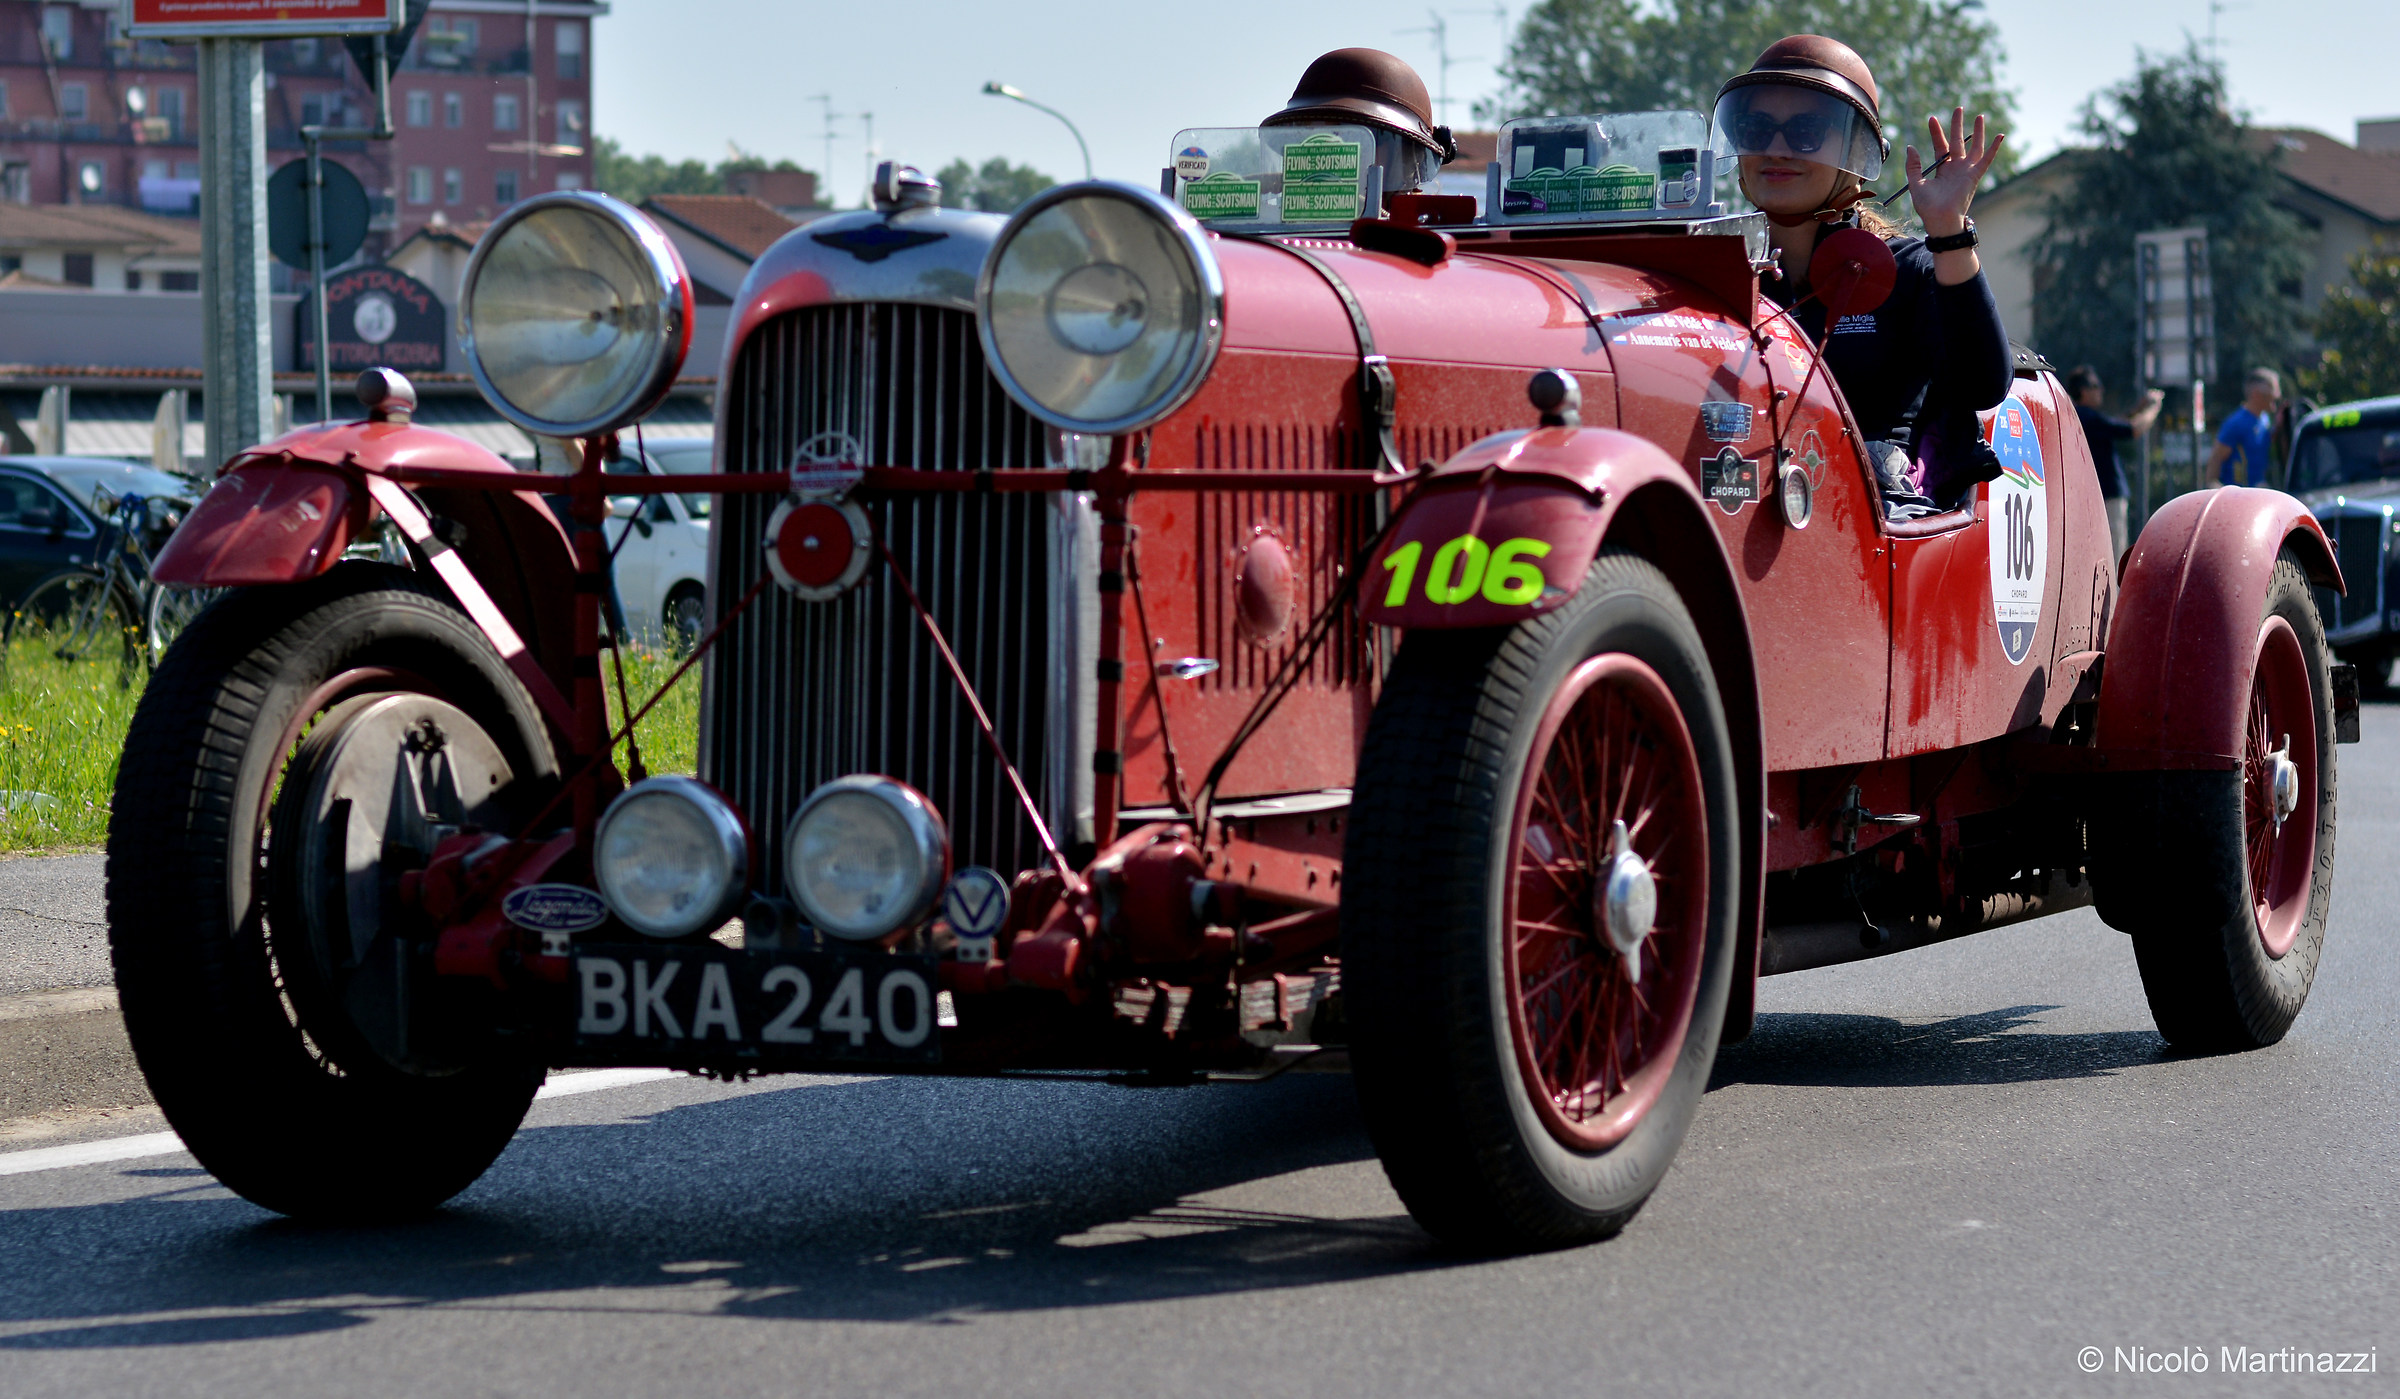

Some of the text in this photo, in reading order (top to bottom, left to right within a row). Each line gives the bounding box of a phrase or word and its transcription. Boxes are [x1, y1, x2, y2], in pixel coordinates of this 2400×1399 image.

[1178, 161, 1207, 170] VERIFICATO
[1286, 154, 1357, 171] FLYING SCOTSMAN
[1187, 192, 1257, 209] FLYING SCOTSMAN
[1285, 194, 1355, 210] FLYING SCOTSMAN
[1548, 190, 1573, 203] FLYING
[1582, 187, 1608, 202] FLYING
[1612, 185, 1653, 200] SCOTSMAN
[326, 270, 428, 314] ONTANA
[1852, 314, 1875, 323] Miglia
[1629, 332, 1738, 351] Annemarie van de Velde
[1710, 486, 1751, 497] CHOPARD
[2005, 493, 2034, 581] 106
[1383, 534, 1552, 608] 106
[576, 957, 931, 1048] BKA 240
